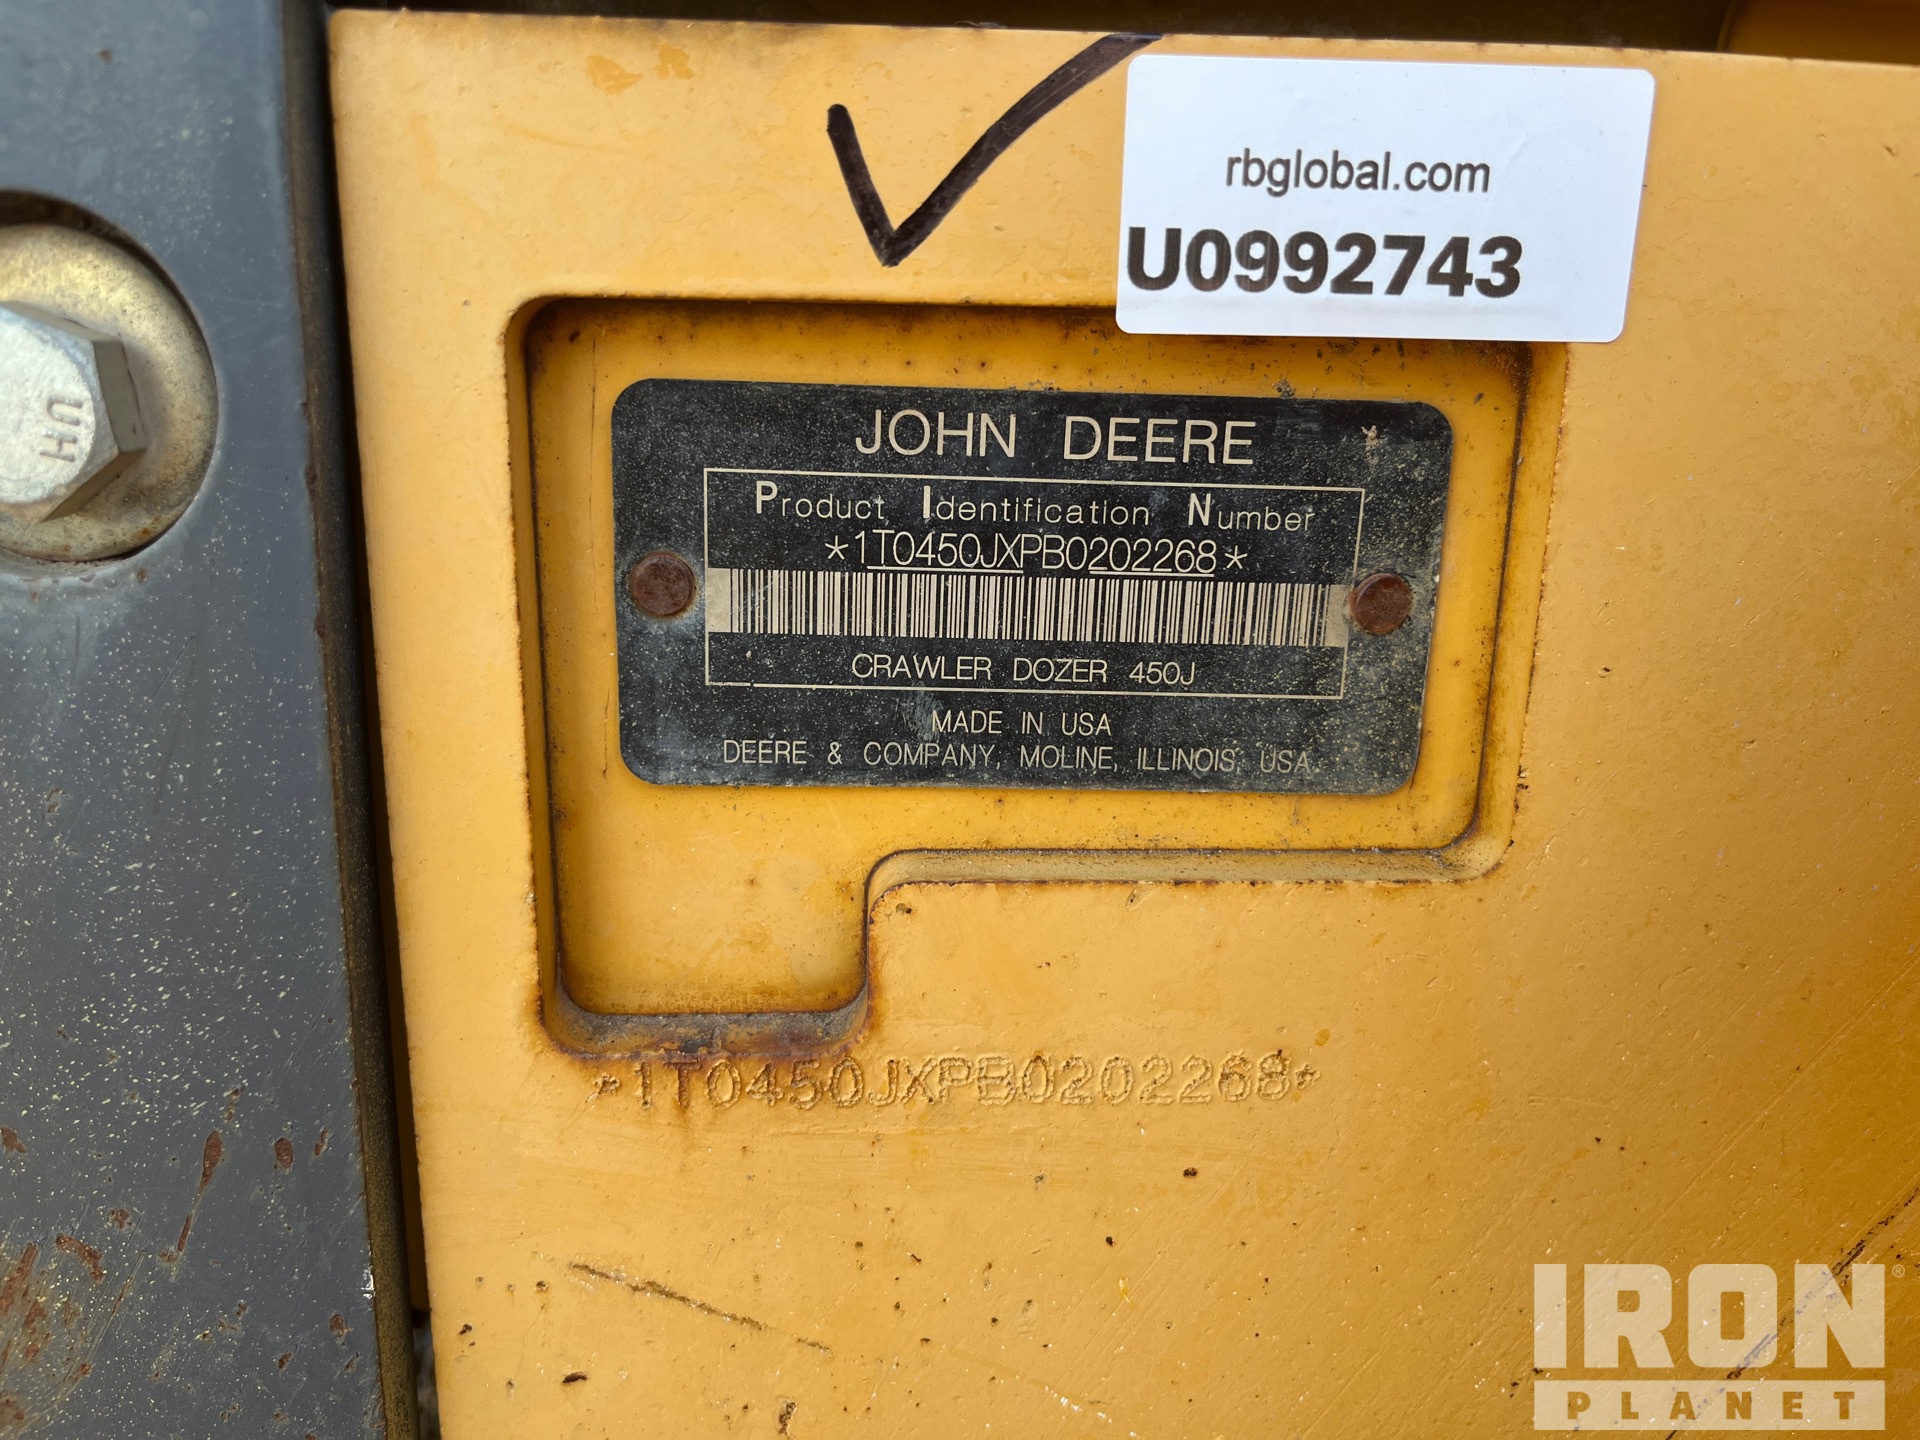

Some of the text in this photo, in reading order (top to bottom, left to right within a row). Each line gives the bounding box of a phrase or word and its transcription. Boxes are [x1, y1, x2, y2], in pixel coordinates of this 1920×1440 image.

[1226, 148, 1490, 197] rbglobal.com
[1126, 225, 1523, 299] U0992743
[855, 409, 1256, 466] JOHN DEERE
[755, 480, 1316, 532] Product Identification Number
[852, 653, 1196, 686] CRAWLER DOZER 450J
[931, 709, 1112, 736] MADE IN USA
[723, 740, 807, 765] DEERE
[827, 742, 843, 766] &
[863, 741, 1001, 770] COMPANY,
[1019, 744, 1118, 772] MOLINE,
[1260, 749, 1311, 774] USA
